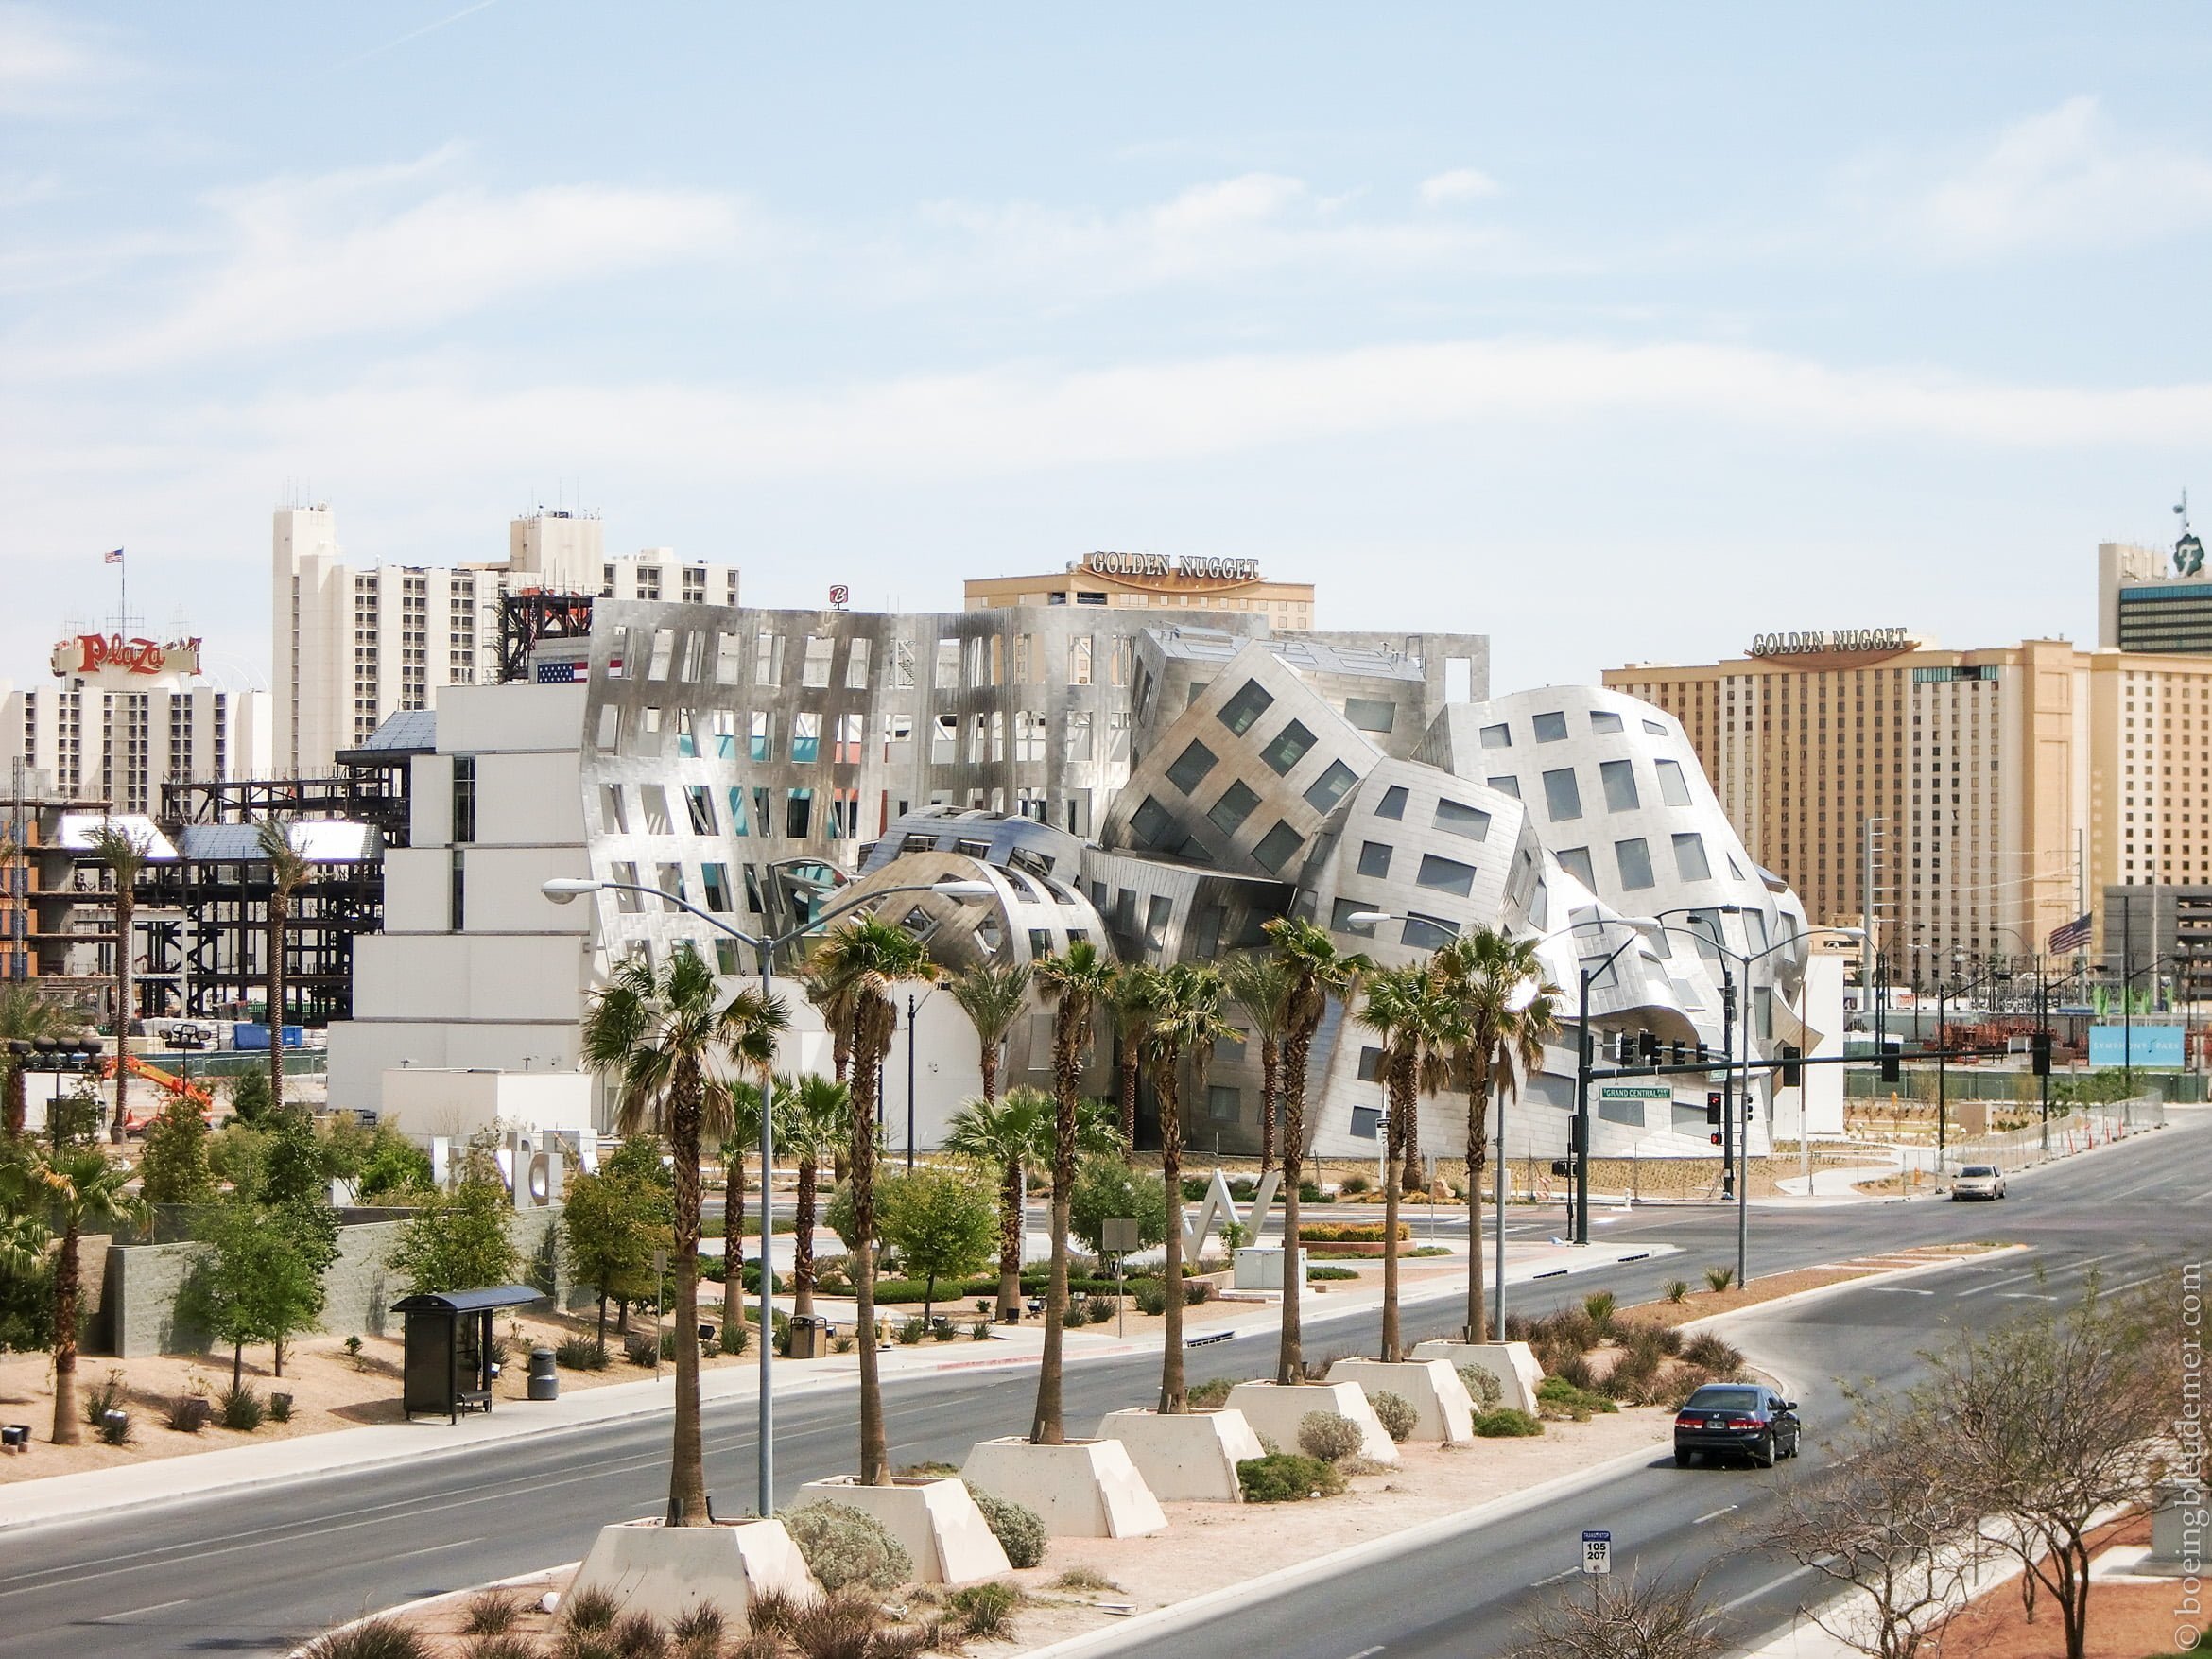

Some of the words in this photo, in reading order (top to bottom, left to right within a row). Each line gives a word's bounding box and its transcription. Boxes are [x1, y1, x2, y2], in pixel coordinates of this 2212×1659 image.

[1092, 551, 1170, 575] GOLDEN
[1180, 555, 1258, 579] NUGGET
[1753, 631, 1824, 656] GOLDEN
[1832, 627, 1908, 652] NUGGET
[1629, 1089, 1657, 1097] CENTRAL
[1587, 1542, 1606, 1551] 105
[1587, 1551, 1606, 1560] 207
